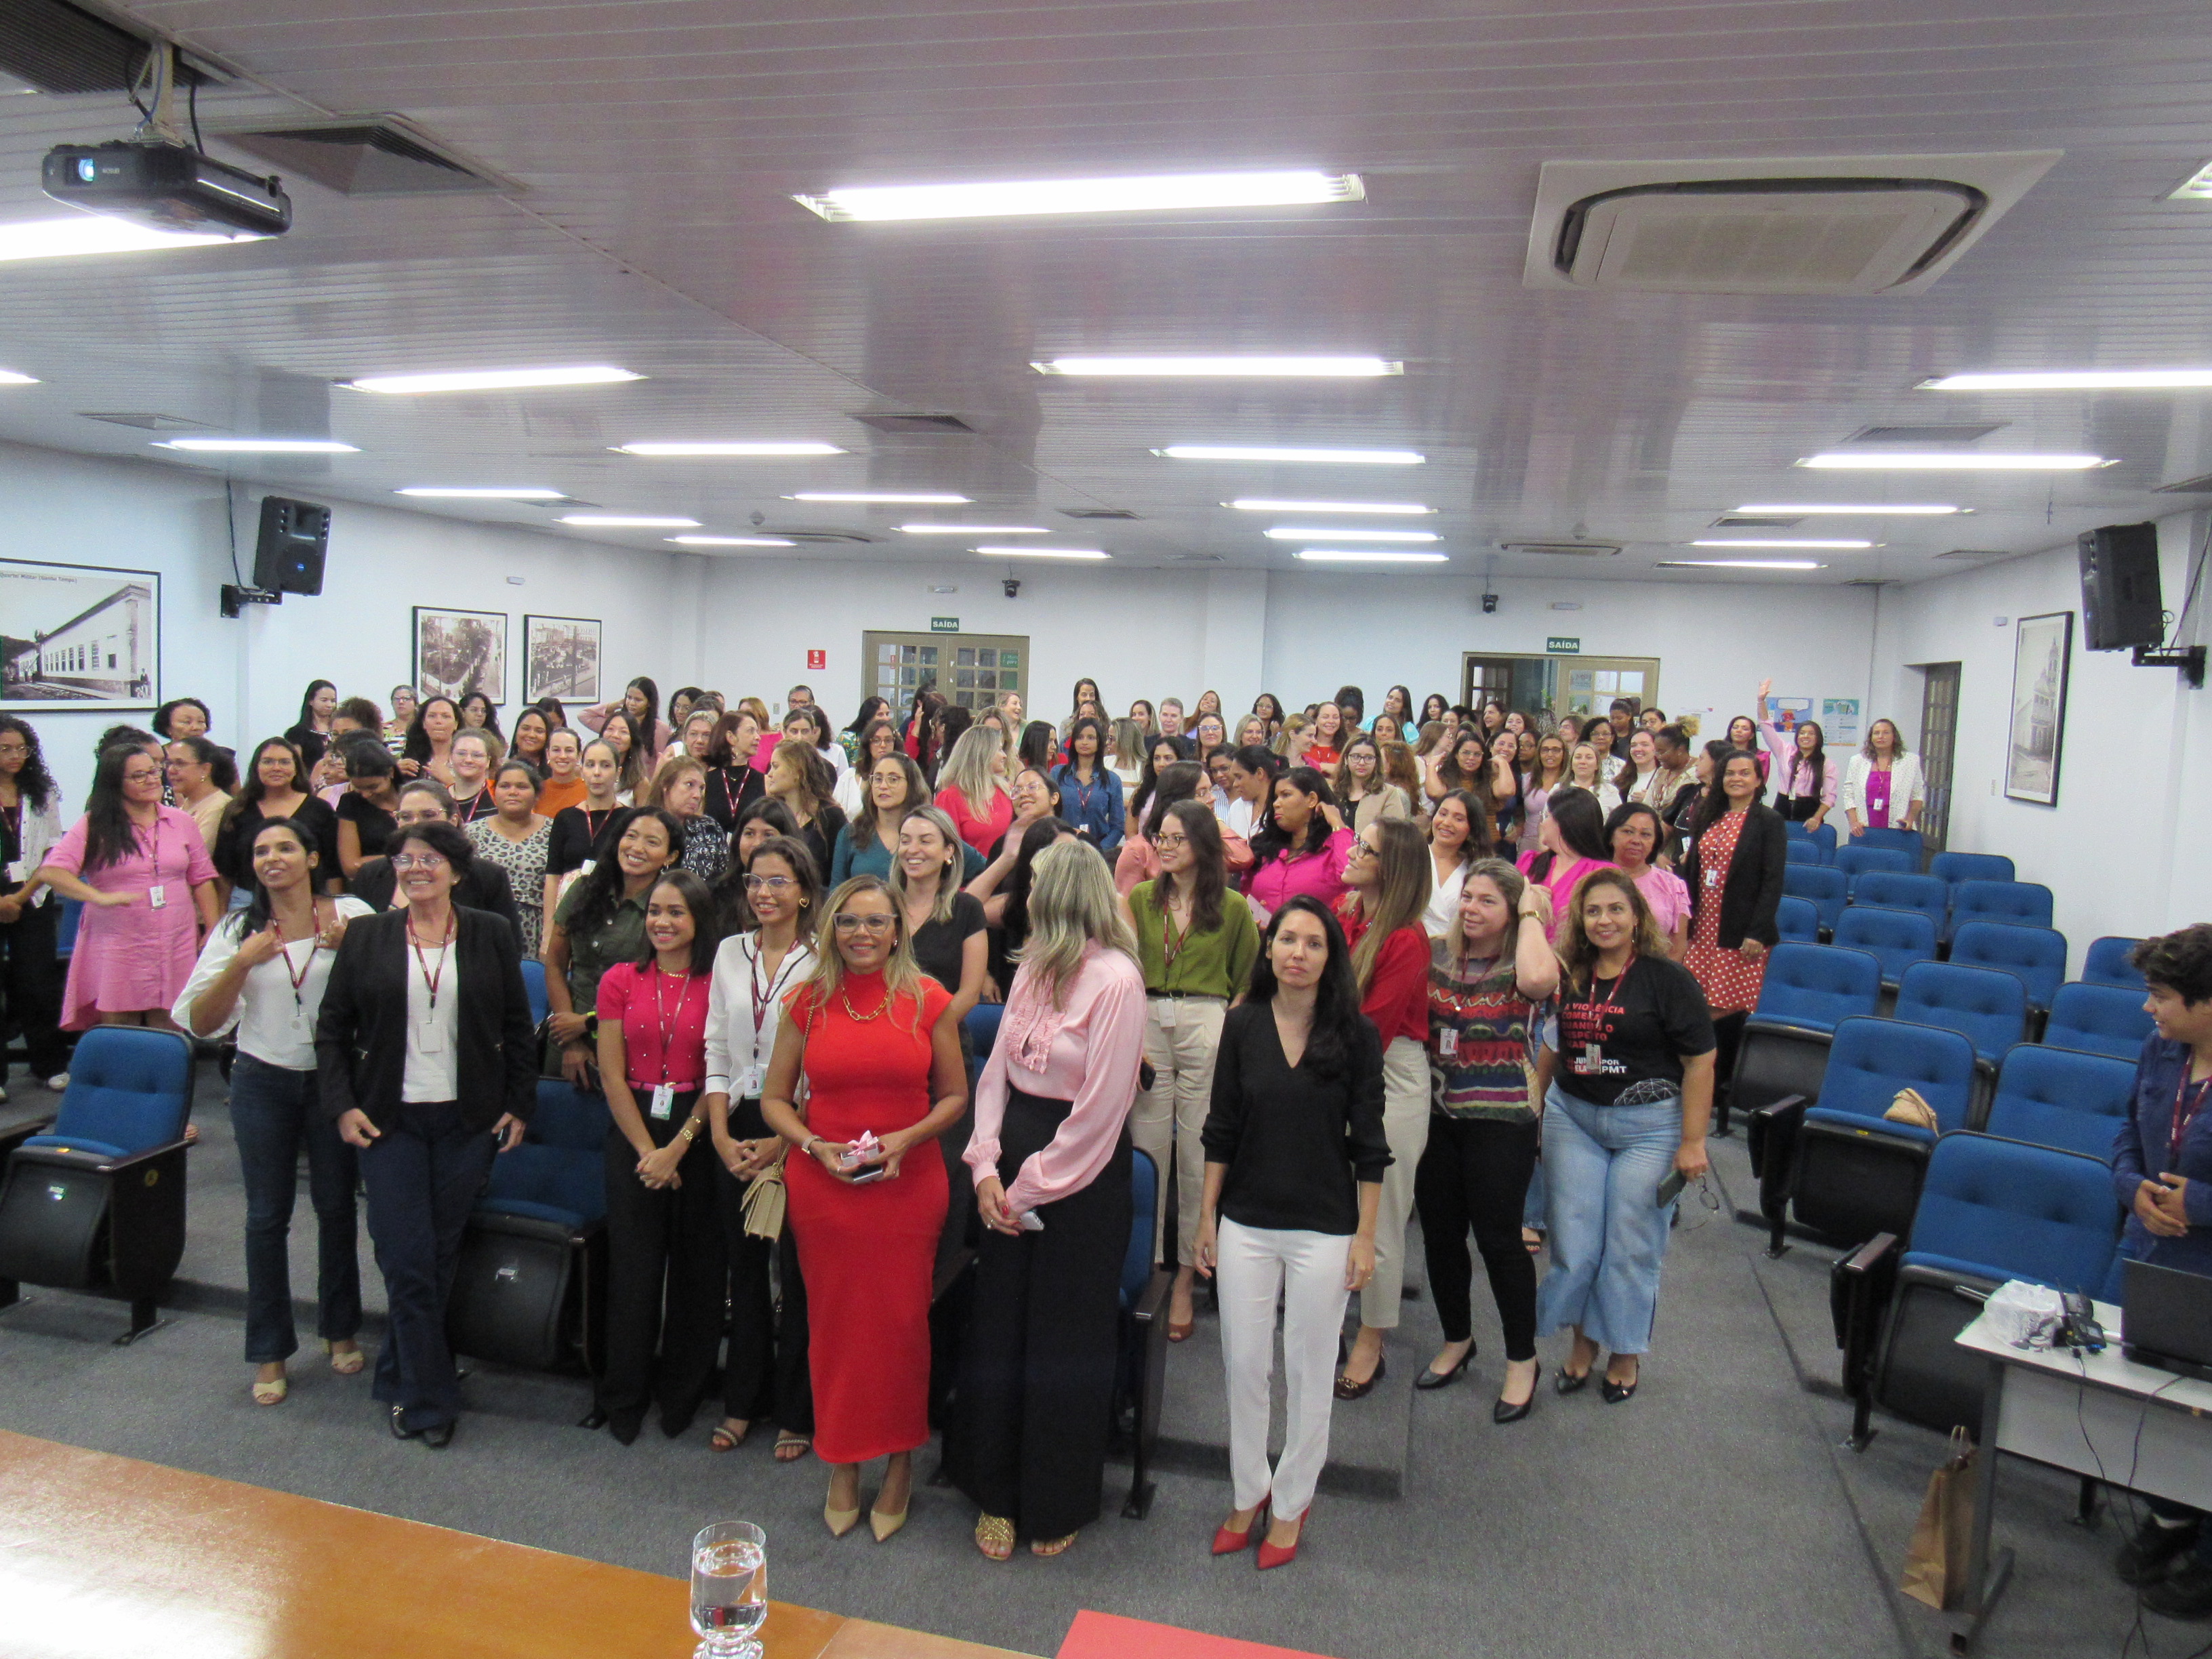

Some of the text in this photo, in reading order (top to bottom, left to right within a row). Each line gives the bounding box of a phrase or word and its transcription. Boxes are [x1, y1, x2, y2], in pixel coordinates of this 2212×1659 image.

[933, 620, 958, 628] SAÍDA
[1549, 640, 1578, 649] SAÍDA
[1572, 1003, 1625, 1014] VIOÊCIA
[1561, 1012, 1600, 1021] COMEA
[1605, 1024, 1614, 1033] O
